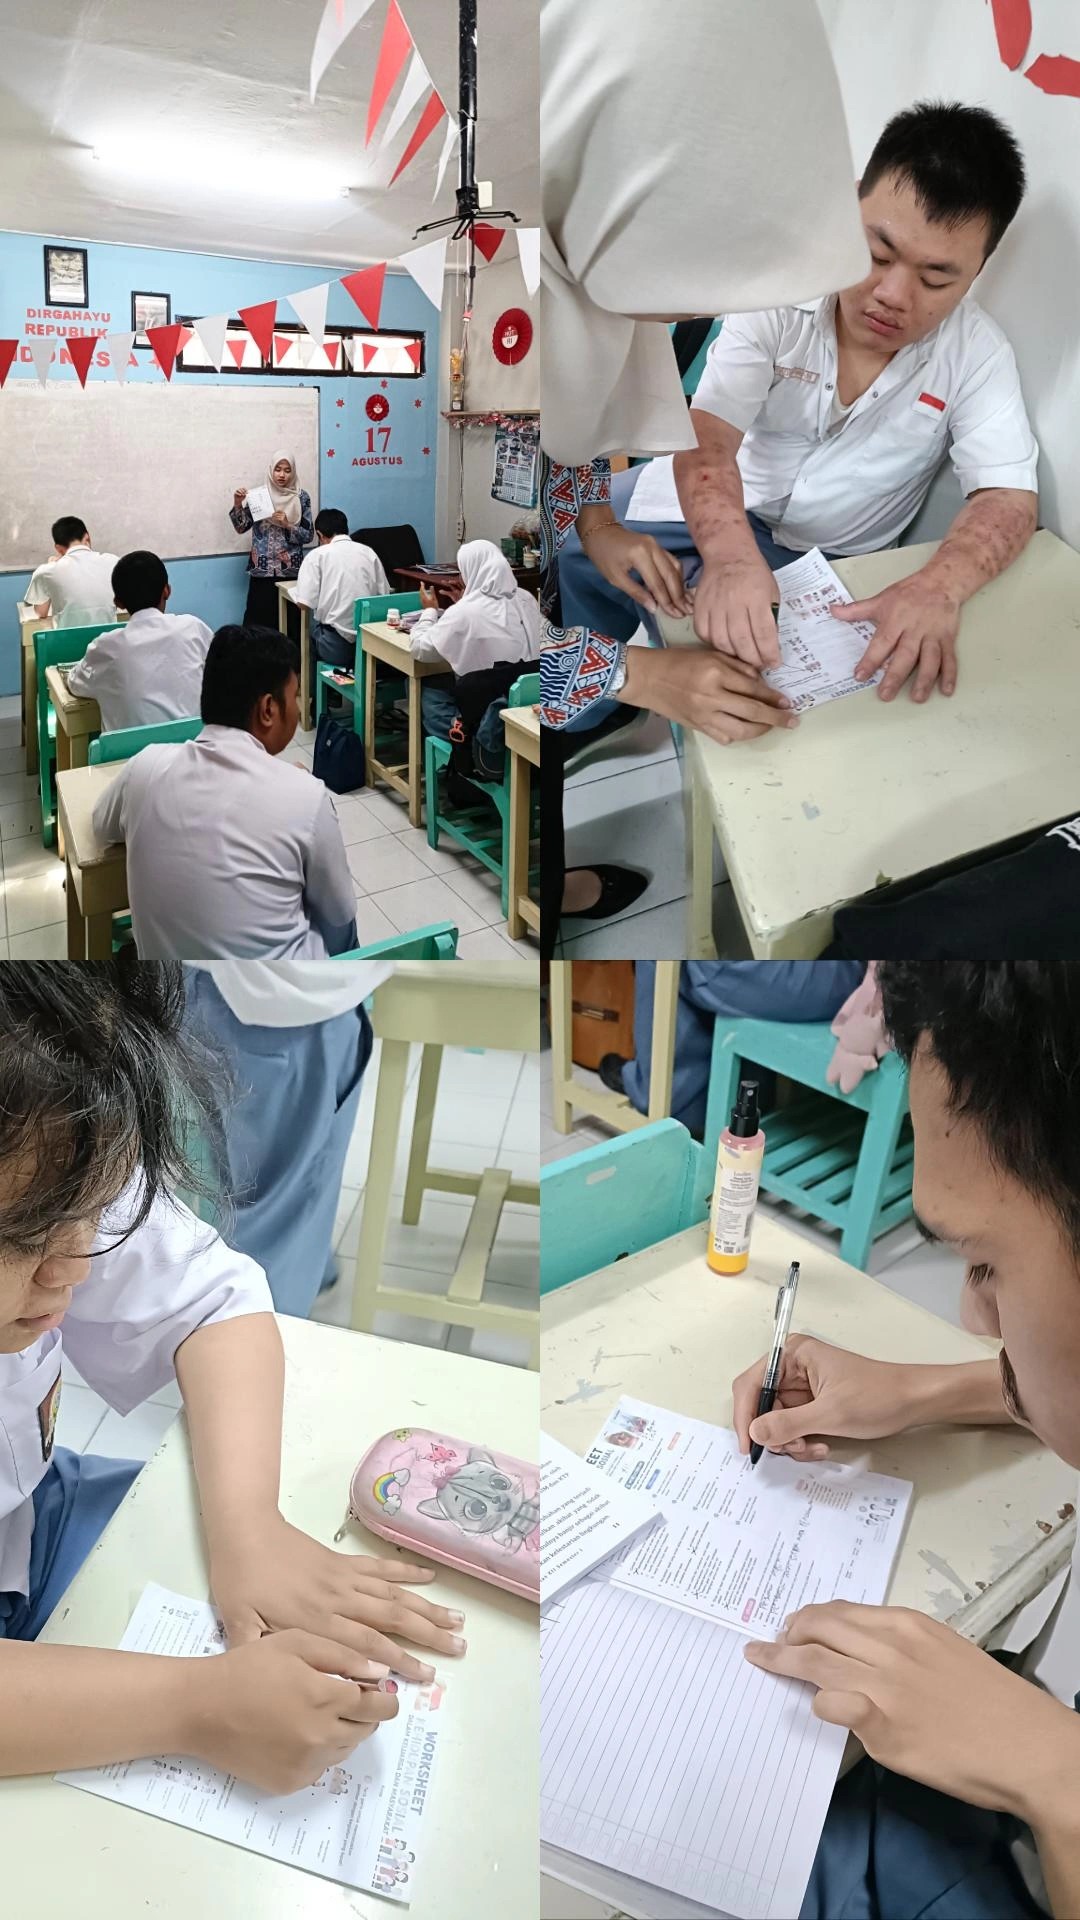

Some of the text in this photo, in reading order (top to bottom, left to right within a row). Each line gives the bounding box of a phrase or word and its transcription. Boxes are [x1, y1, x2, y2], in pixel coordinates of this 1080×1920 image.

[27, 308, 111, 323] DIRGAHAYU
[25, 323, 108, 339] REPUBLIK
[365, 427, 392, 453] 17
[352, 456, 403, 466] AGUSTUS
[586, 1448, 603, 1465] EET
[596, 1449, 615, 1469] SOSIAL
[410, 1731, 438, 1816] WORKSHEET
[391, 1788, 411, 1833] SOSIAL
